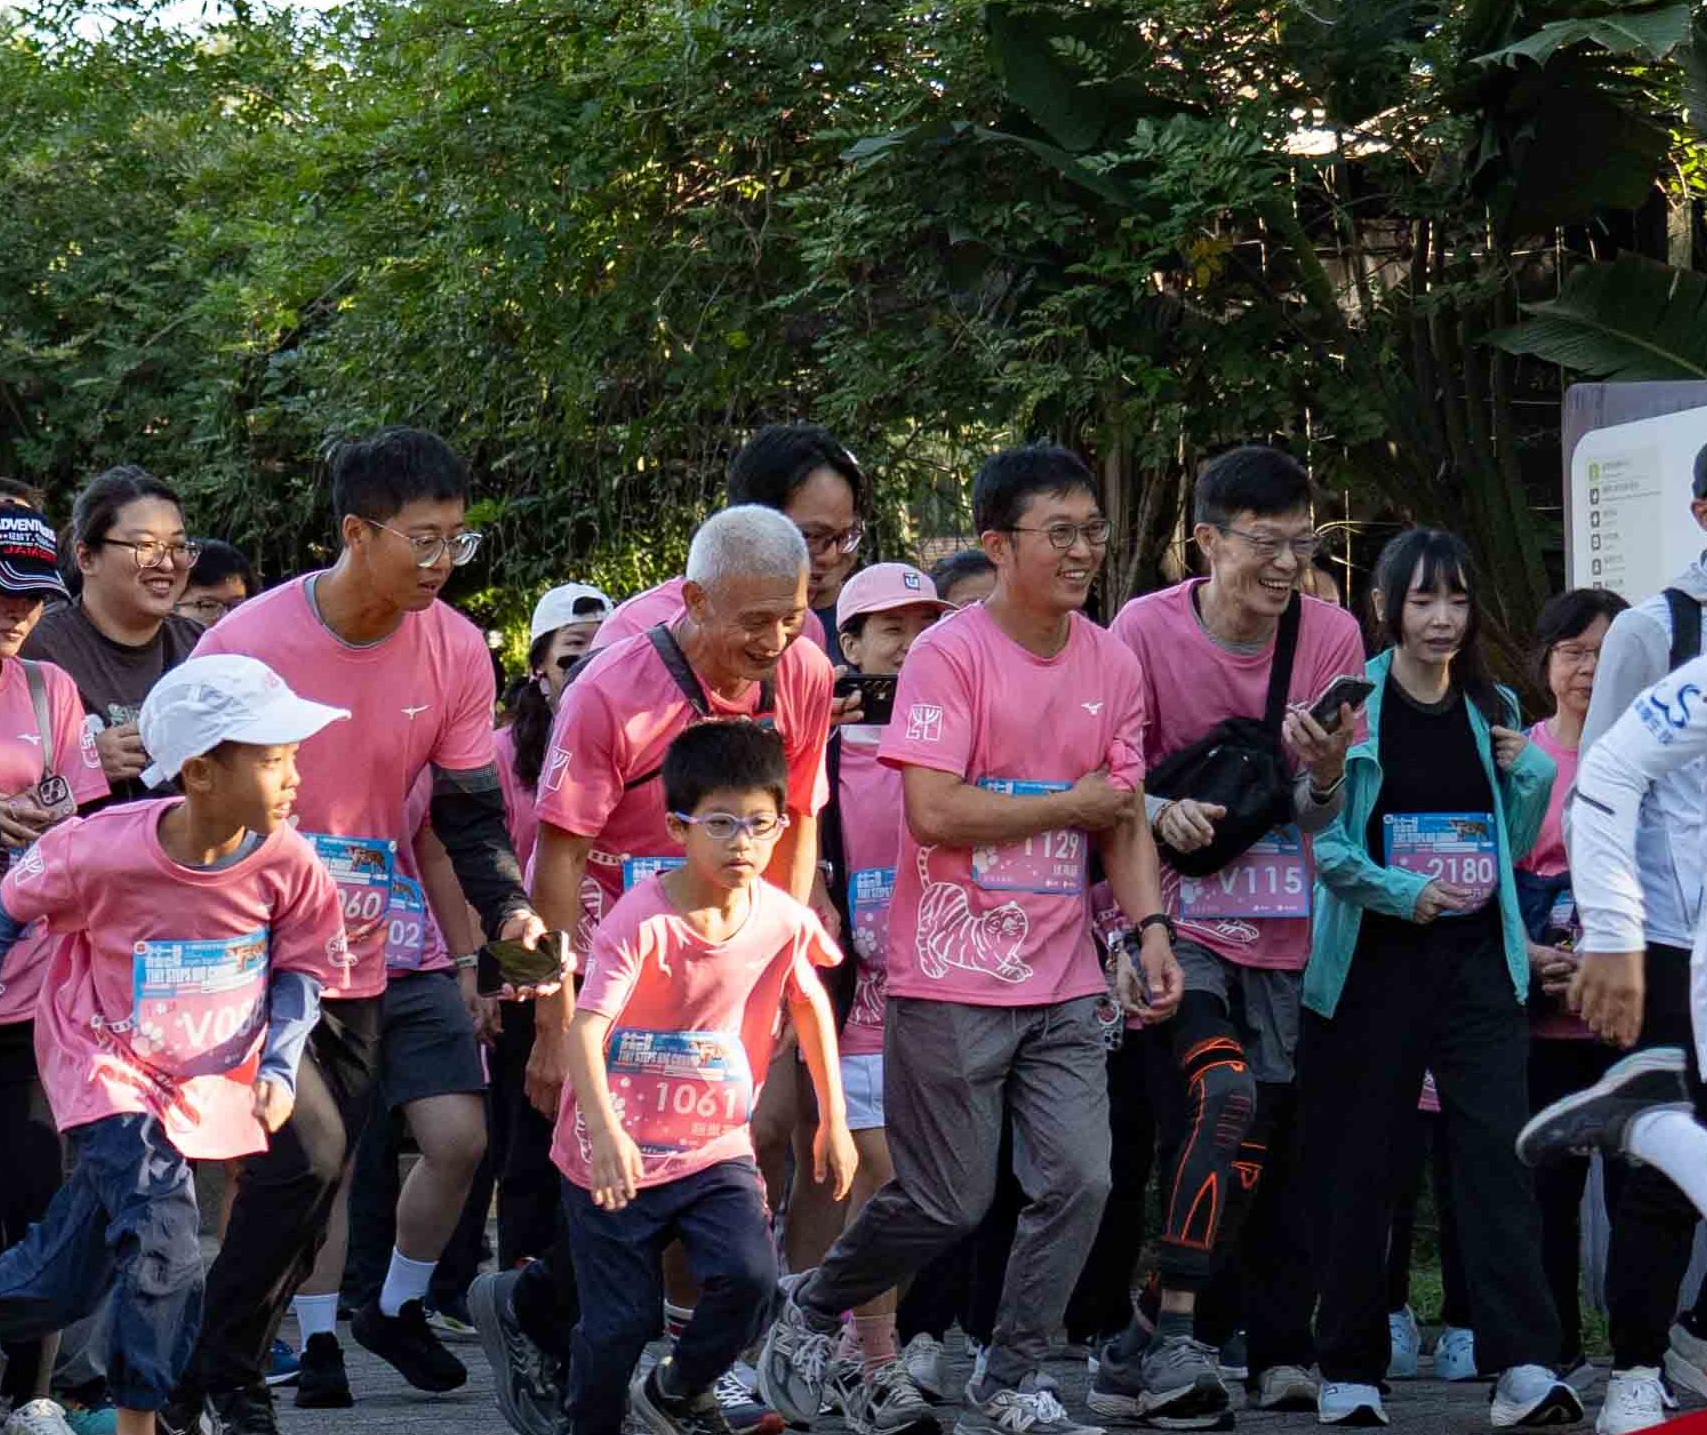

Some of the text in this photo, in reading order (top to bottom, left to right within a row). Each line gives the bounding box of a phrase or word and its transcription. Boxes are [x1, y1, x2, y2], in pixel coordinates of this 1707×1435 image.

[1217, 865, 1303, 895] V115
[1427, 857, 1493, 884] 2180
[657, 1081, 737, 1120] 1061
